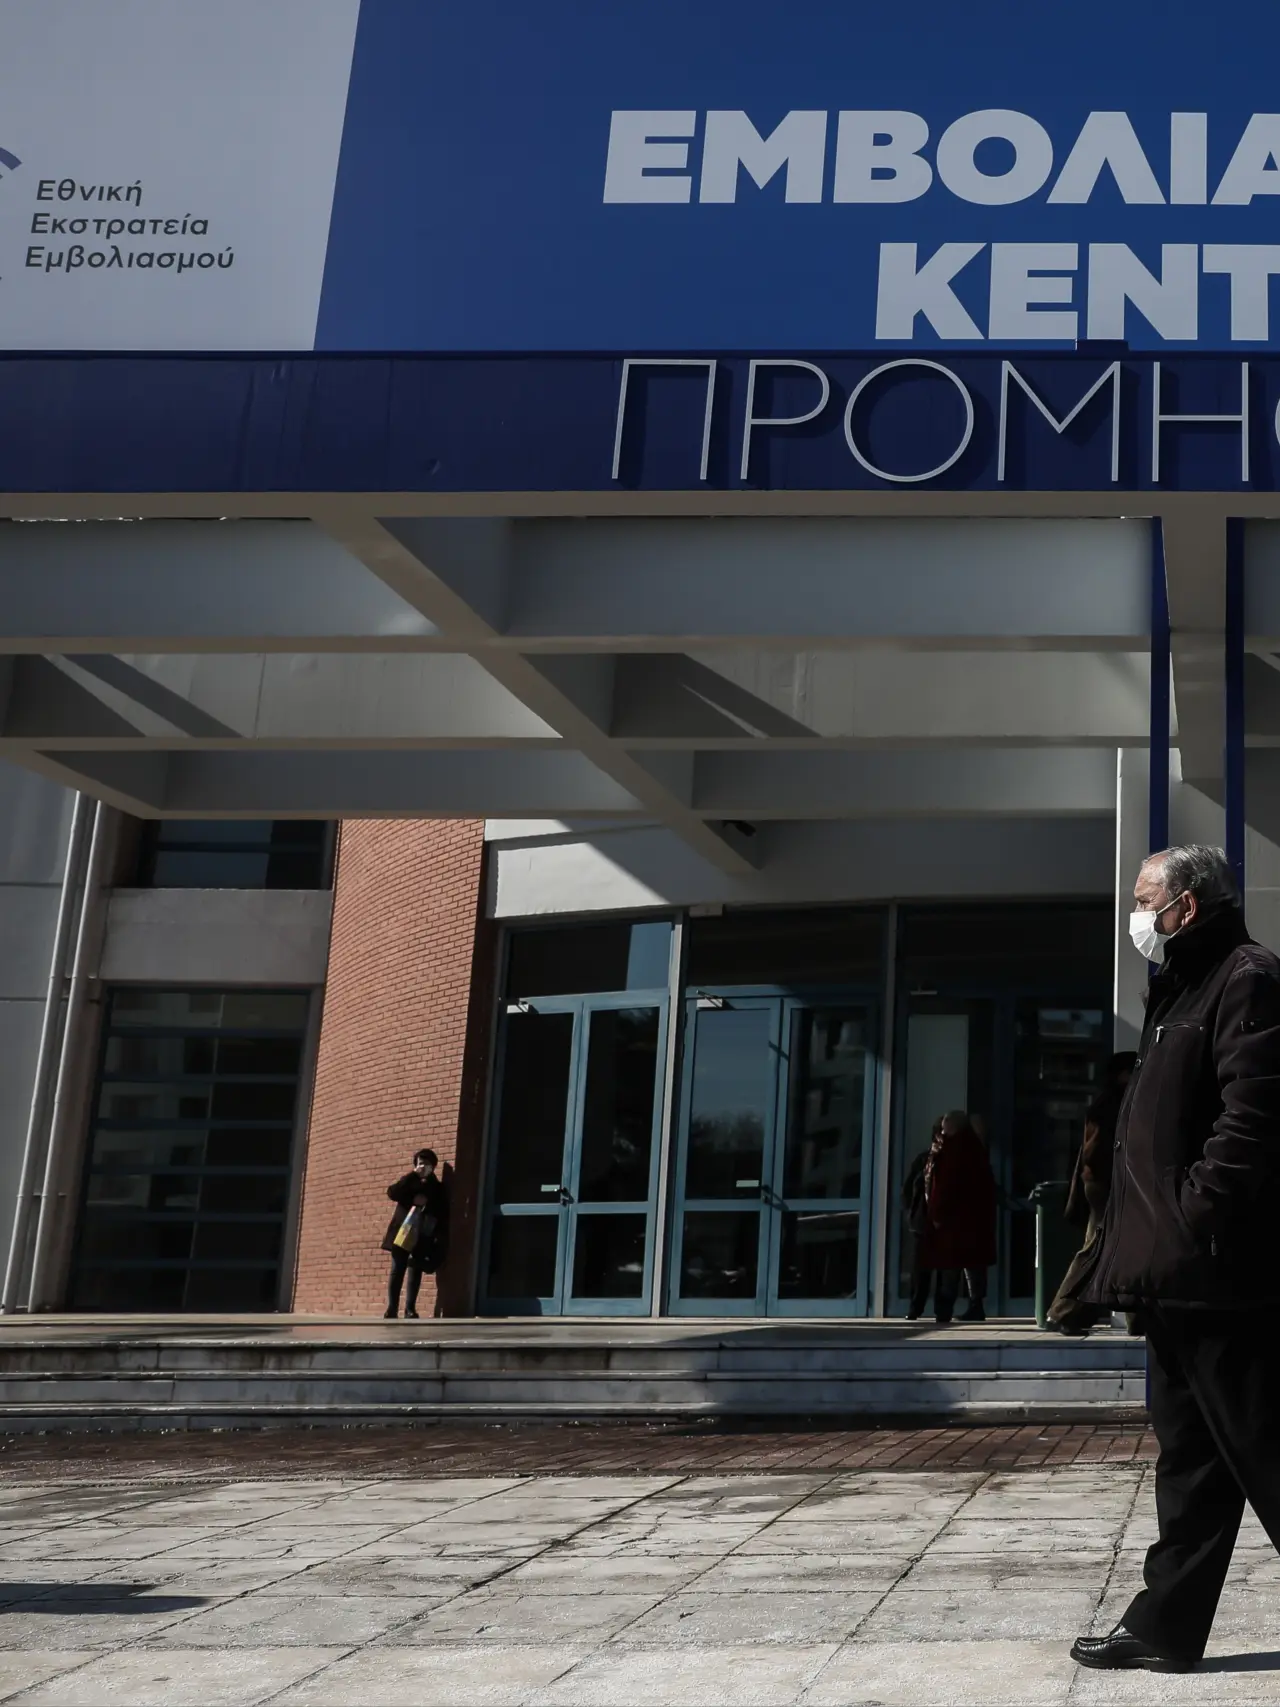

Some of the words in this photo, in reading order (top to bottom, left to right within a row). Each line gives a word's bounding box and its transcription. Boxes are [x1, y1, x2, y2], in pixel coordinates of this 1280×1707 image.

[36, 178, 143, 207] Εθνική
[30, 212, 209, 240] Εκστρατεία
[24, 244, 235, 274] Εμβολιασμού
